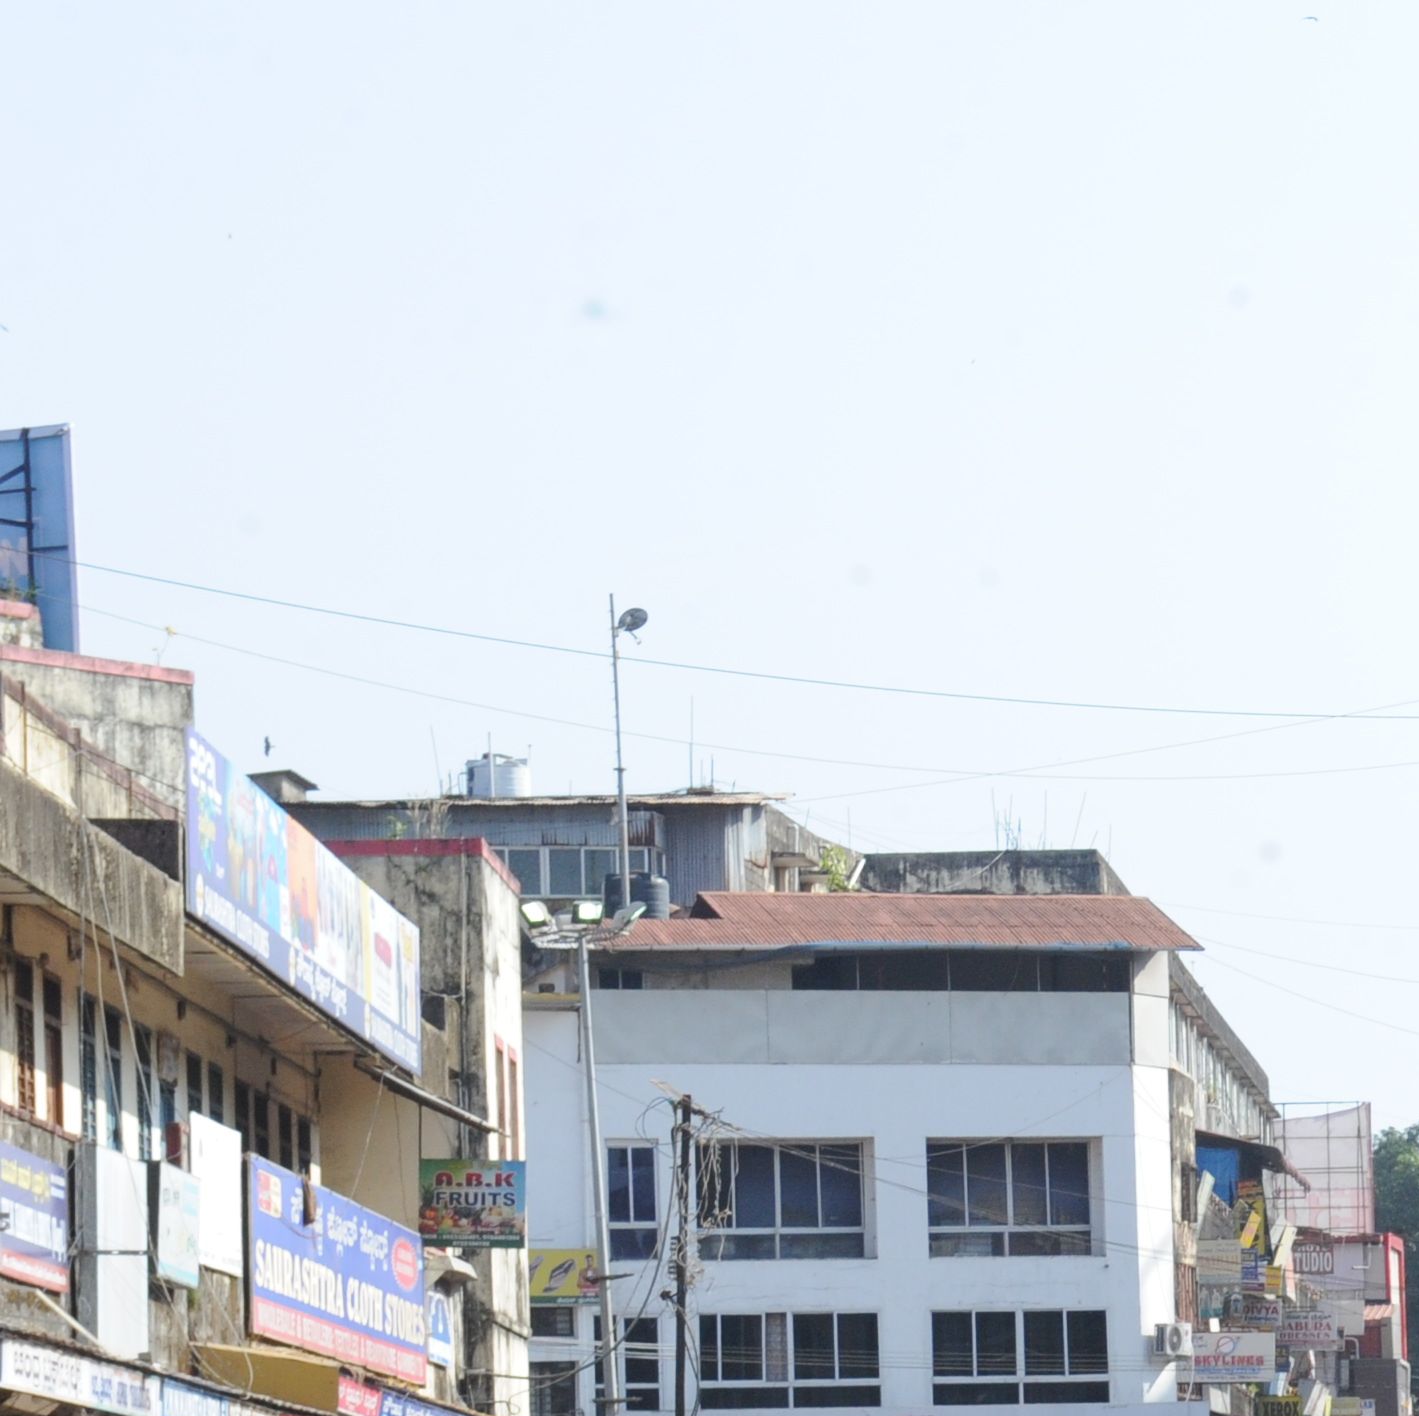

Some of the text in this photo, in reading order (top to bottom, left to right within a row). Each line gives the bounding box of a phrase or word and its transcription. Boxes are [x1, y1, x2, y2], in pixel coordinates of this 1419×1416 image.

[435, 1171, 516, 1188] A.B.K
[434, 1191, 516, 1207] FRUITS
[1294, 1250, 1333, 1273] TUDIO
[255, 1238, 427, 1347] SAURASHTRA CLOTH STORES
[1193, 1355, 1265, 1367] SKYLINES
